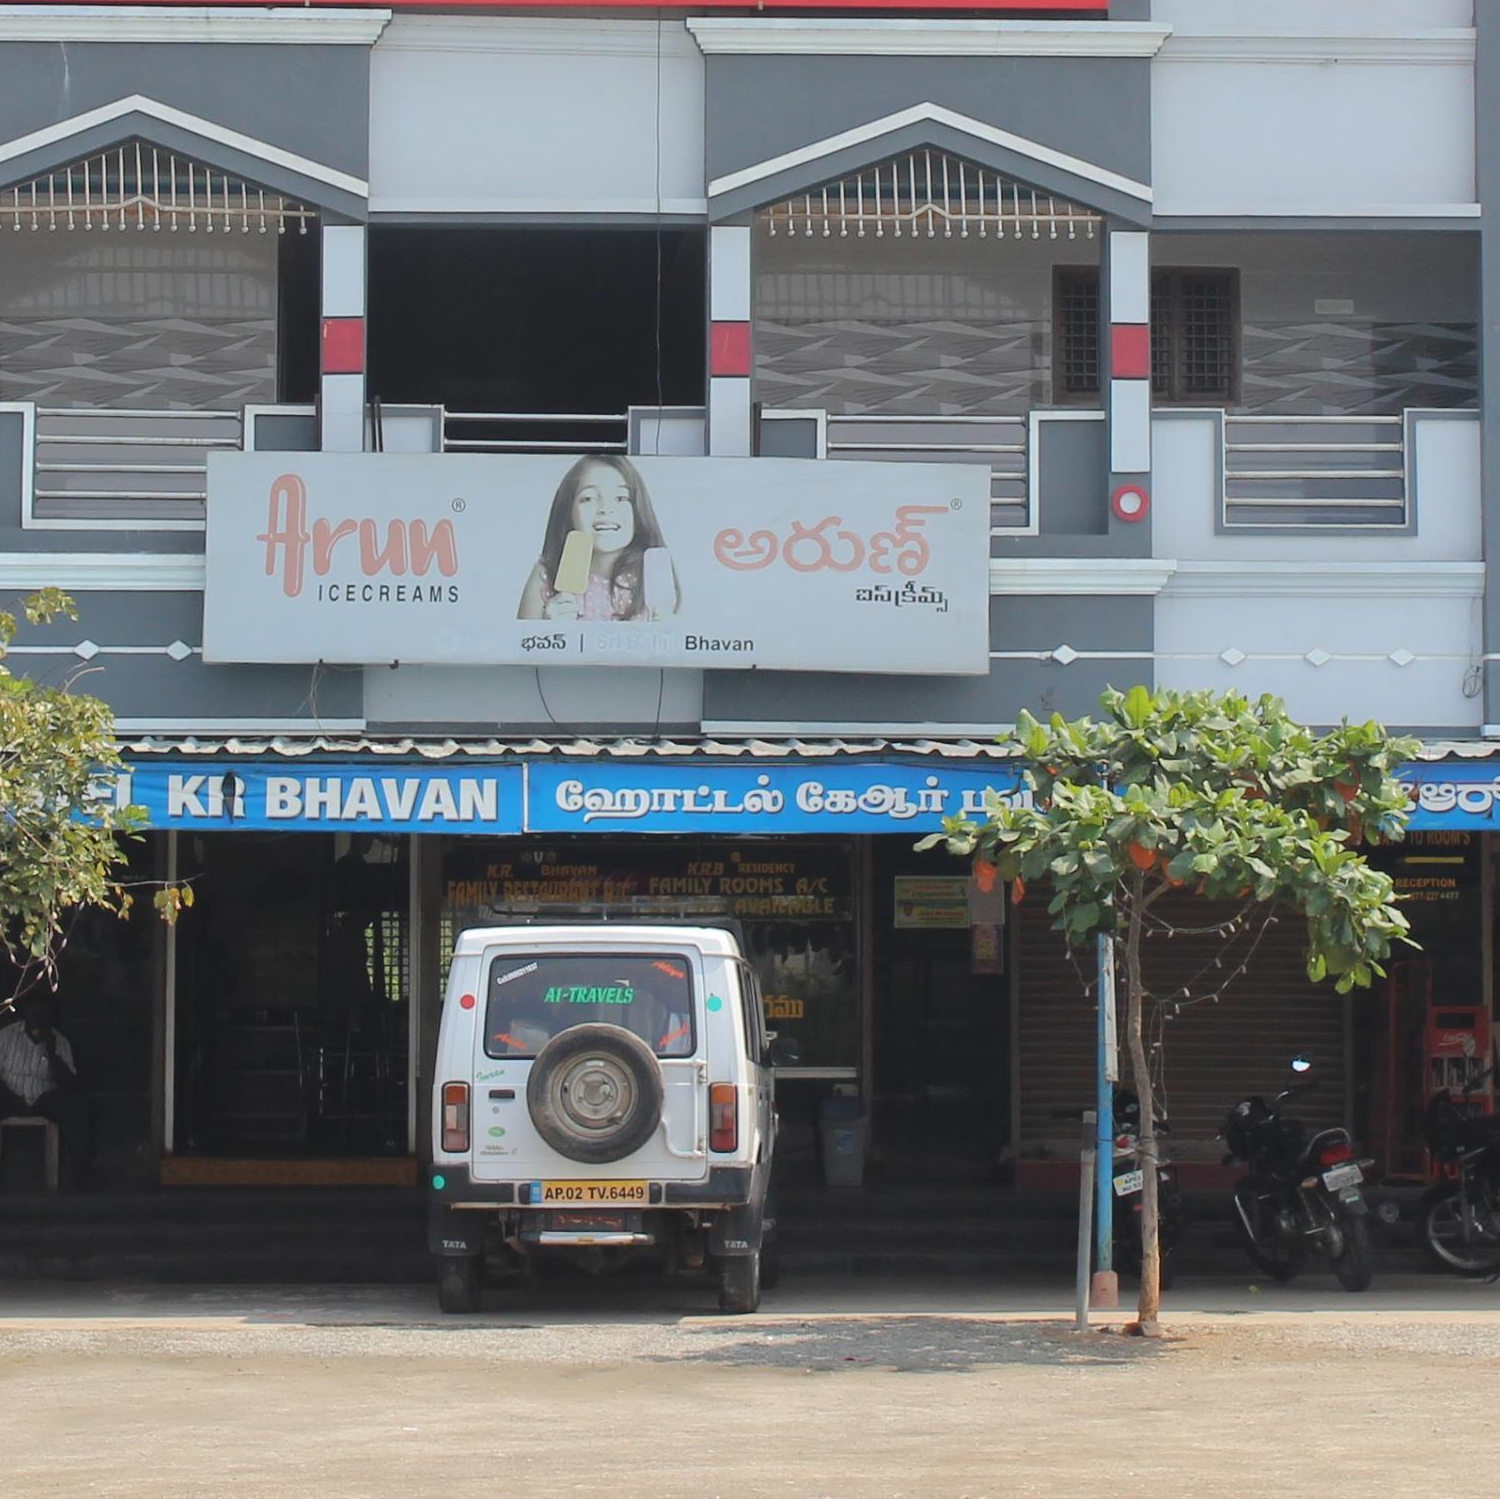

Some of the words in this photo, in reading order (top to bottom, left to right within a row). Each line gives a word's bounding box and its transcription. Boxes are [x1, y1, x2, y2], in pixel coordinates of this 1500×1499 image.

[257, 473, 459, 598] Arun
[713, 504, 949, 577] అరుణ్
[318, 584, 460, 603] ICECREAMS
[521, 634, 567, 651] భవన్
[685, 635, 755, 651] Bhavan
[167, 774, 247, 818] KR
[265, 777, 499, 822] BHAVAN
[555, 773, 785, 824] ஹோட்டல்
[795, 775, 950, 819] கேஆர்
[737, 862, 796, 875] RESIDENCY
[649, 877, 713, 895] FAMILY
[719, 877, 784, 894] ROOMS
[795, 877, 829, 895] A/C
[1395, 876, 1456, 889] RECEPTION
[447, 880, 500, 905] FAMILY
[544, 1186, 583, 1200] AP.02
[587, 1186, 645, 1200] TV.6449
[442, 1239, 467, 1250] TATA
[723, 1239, 748, 1250] TATA
